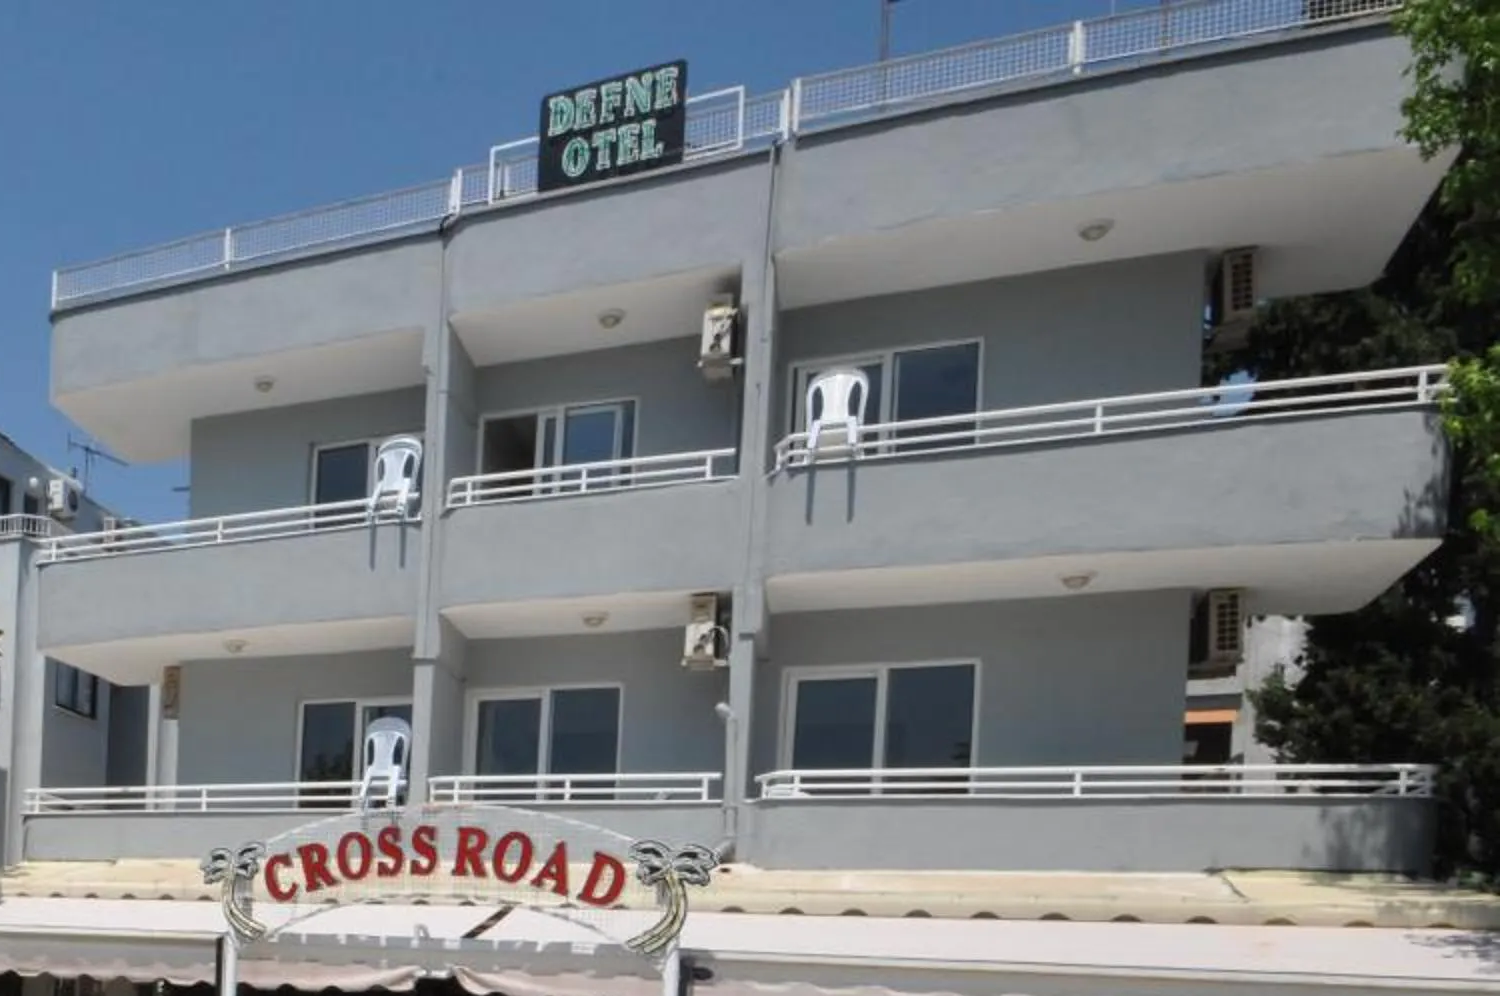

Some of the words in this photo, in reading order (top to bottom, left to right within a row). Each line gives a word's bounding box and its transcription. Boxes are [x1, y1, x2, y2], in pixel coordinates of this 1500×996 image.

[548, 66, 679, 137] DEFNE
[561, 118, 665, 178] OTEL
[264, 825, 438, 901] CROSS
[452, 826, 627, 908] ROAD
